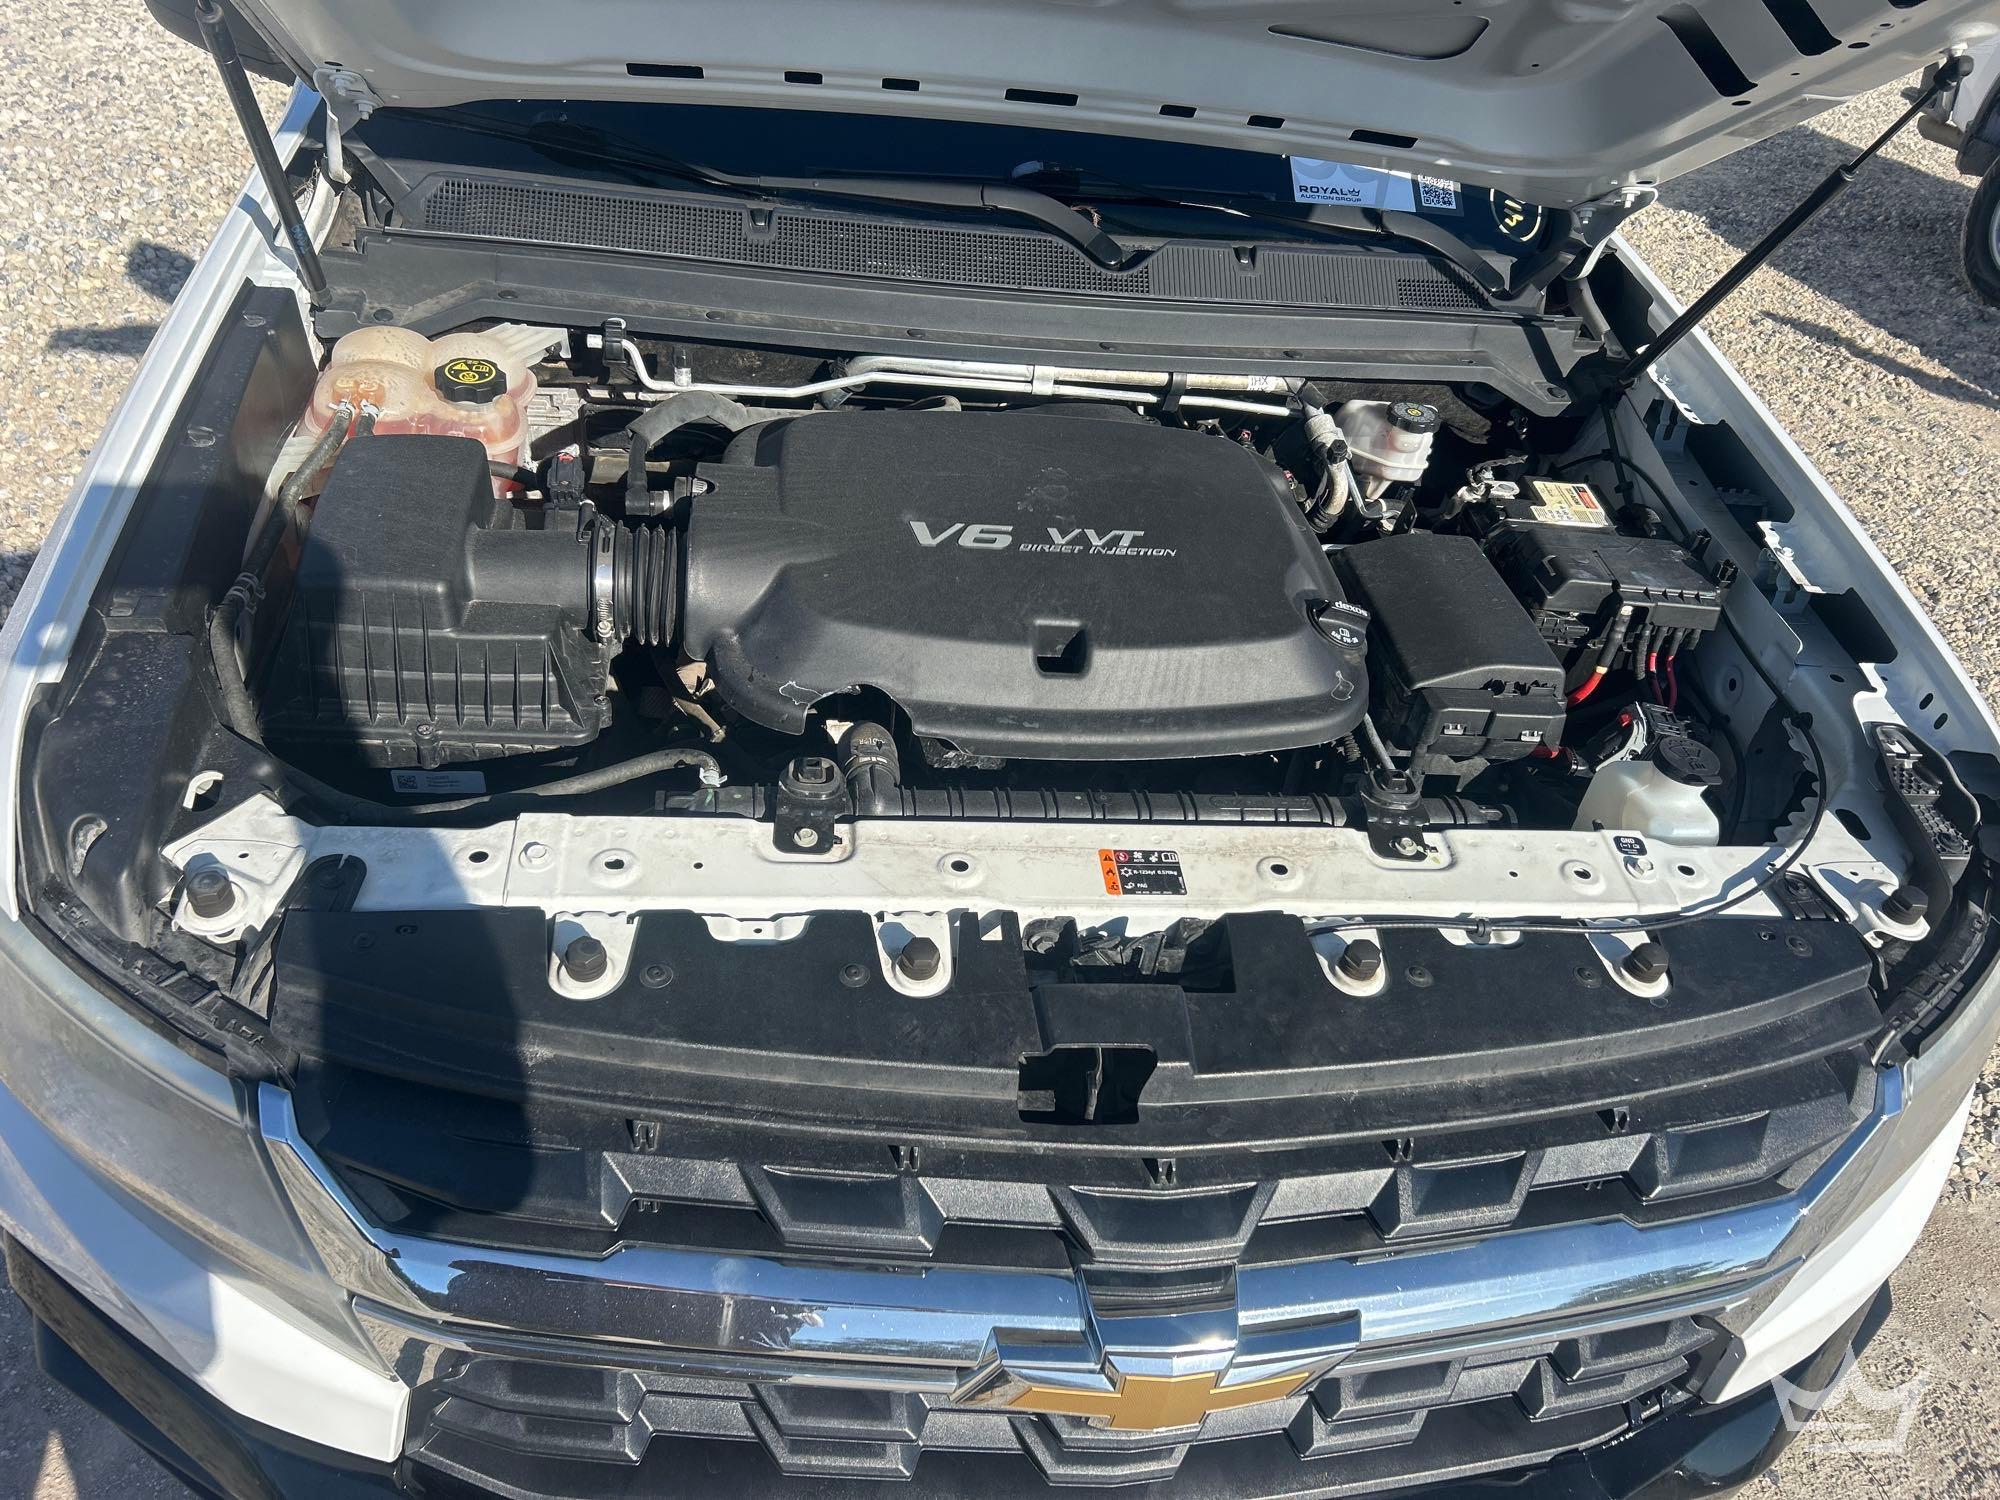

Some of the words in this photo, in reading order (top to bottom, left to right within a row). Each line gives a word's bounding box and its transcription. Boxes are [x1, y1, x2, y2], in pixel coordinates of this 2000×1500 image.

[1299, 185, 1348, 196] ROYAL
[1300, 193, 1334, 201] AUCTION
[909, 521, 1014, 550] V6
[1047, 527, 1145, 546] VVT
[1019, 543, 1084, 553] DIRECT
[1089, 545, 1177, 557] INJECTION
[1335, 601, 1367, 617] dexos
